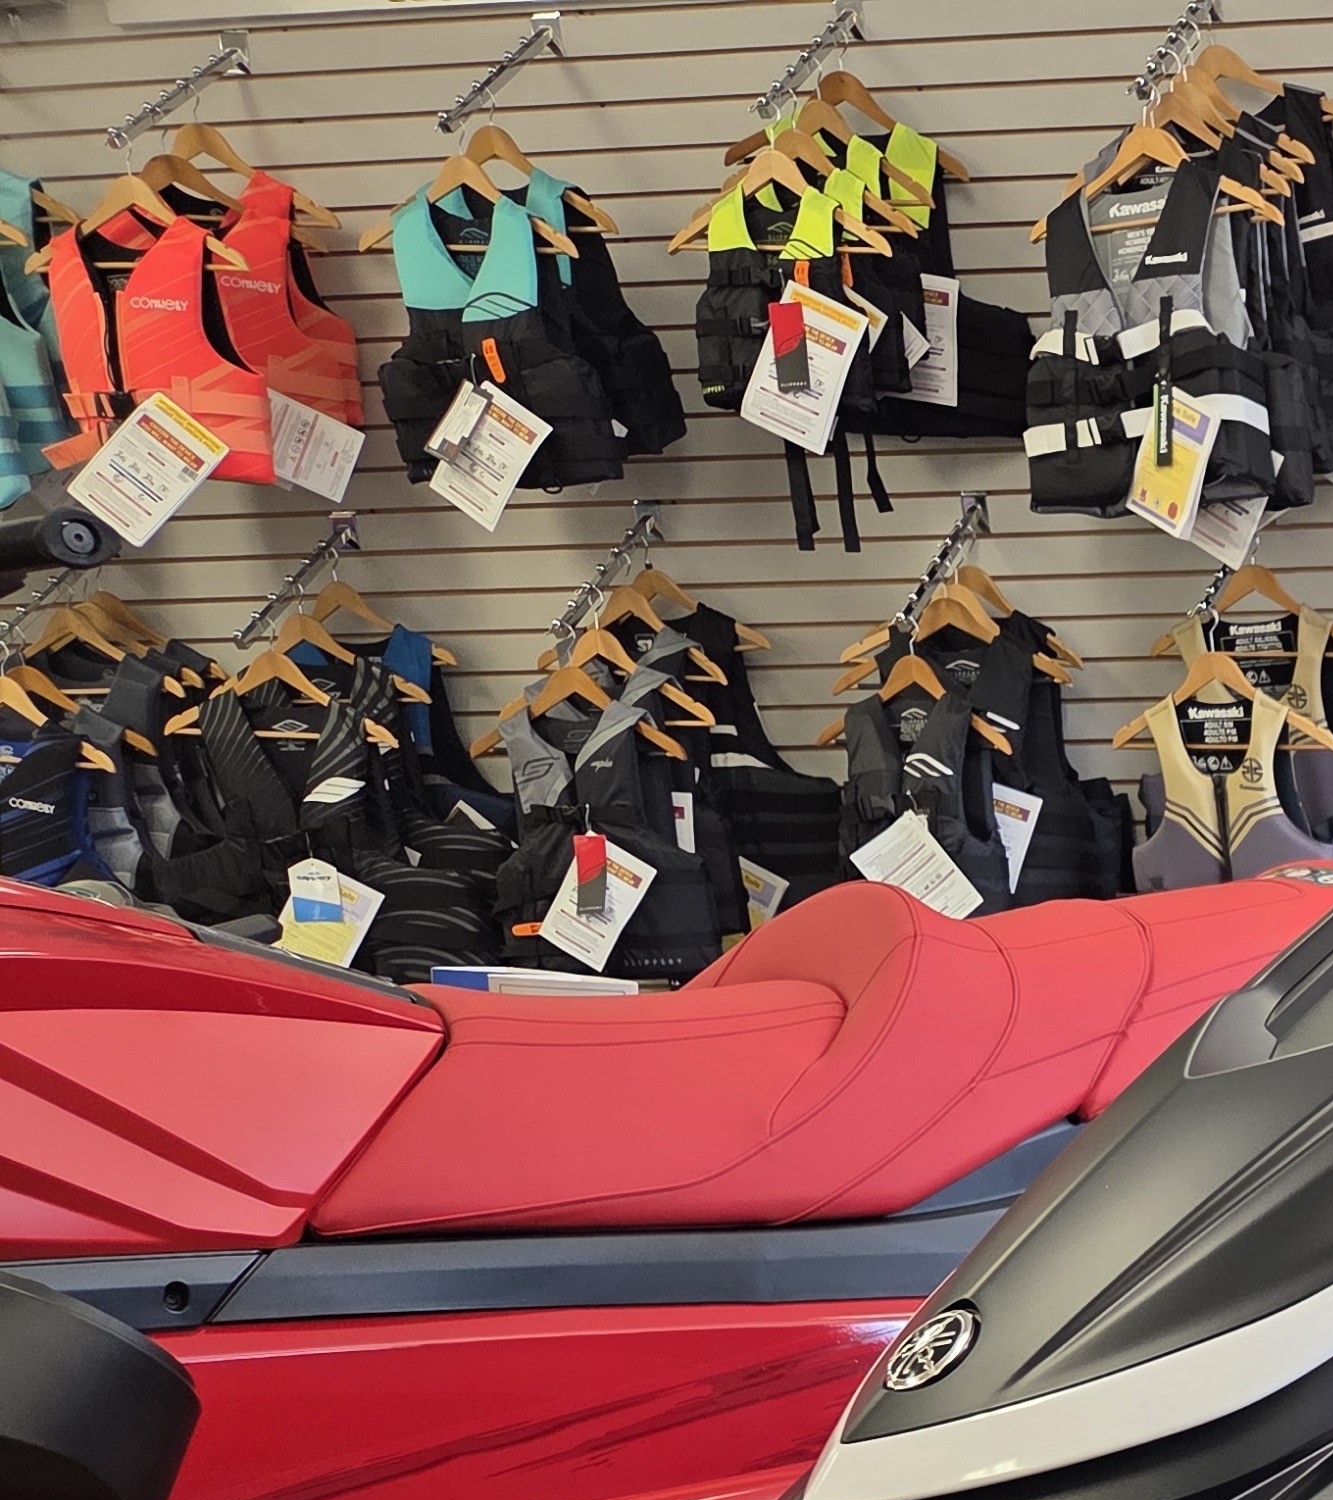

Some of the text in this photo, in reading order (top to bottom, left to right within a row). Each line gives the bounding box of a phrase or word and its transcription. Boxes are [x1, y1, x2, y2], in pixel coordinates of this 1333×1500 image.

[1109, 198, 1167, 218] Kawasa
[1229, 620, 1282, 636] Kawasaki
[1188, 706, 1244, 719] Kawasaki
